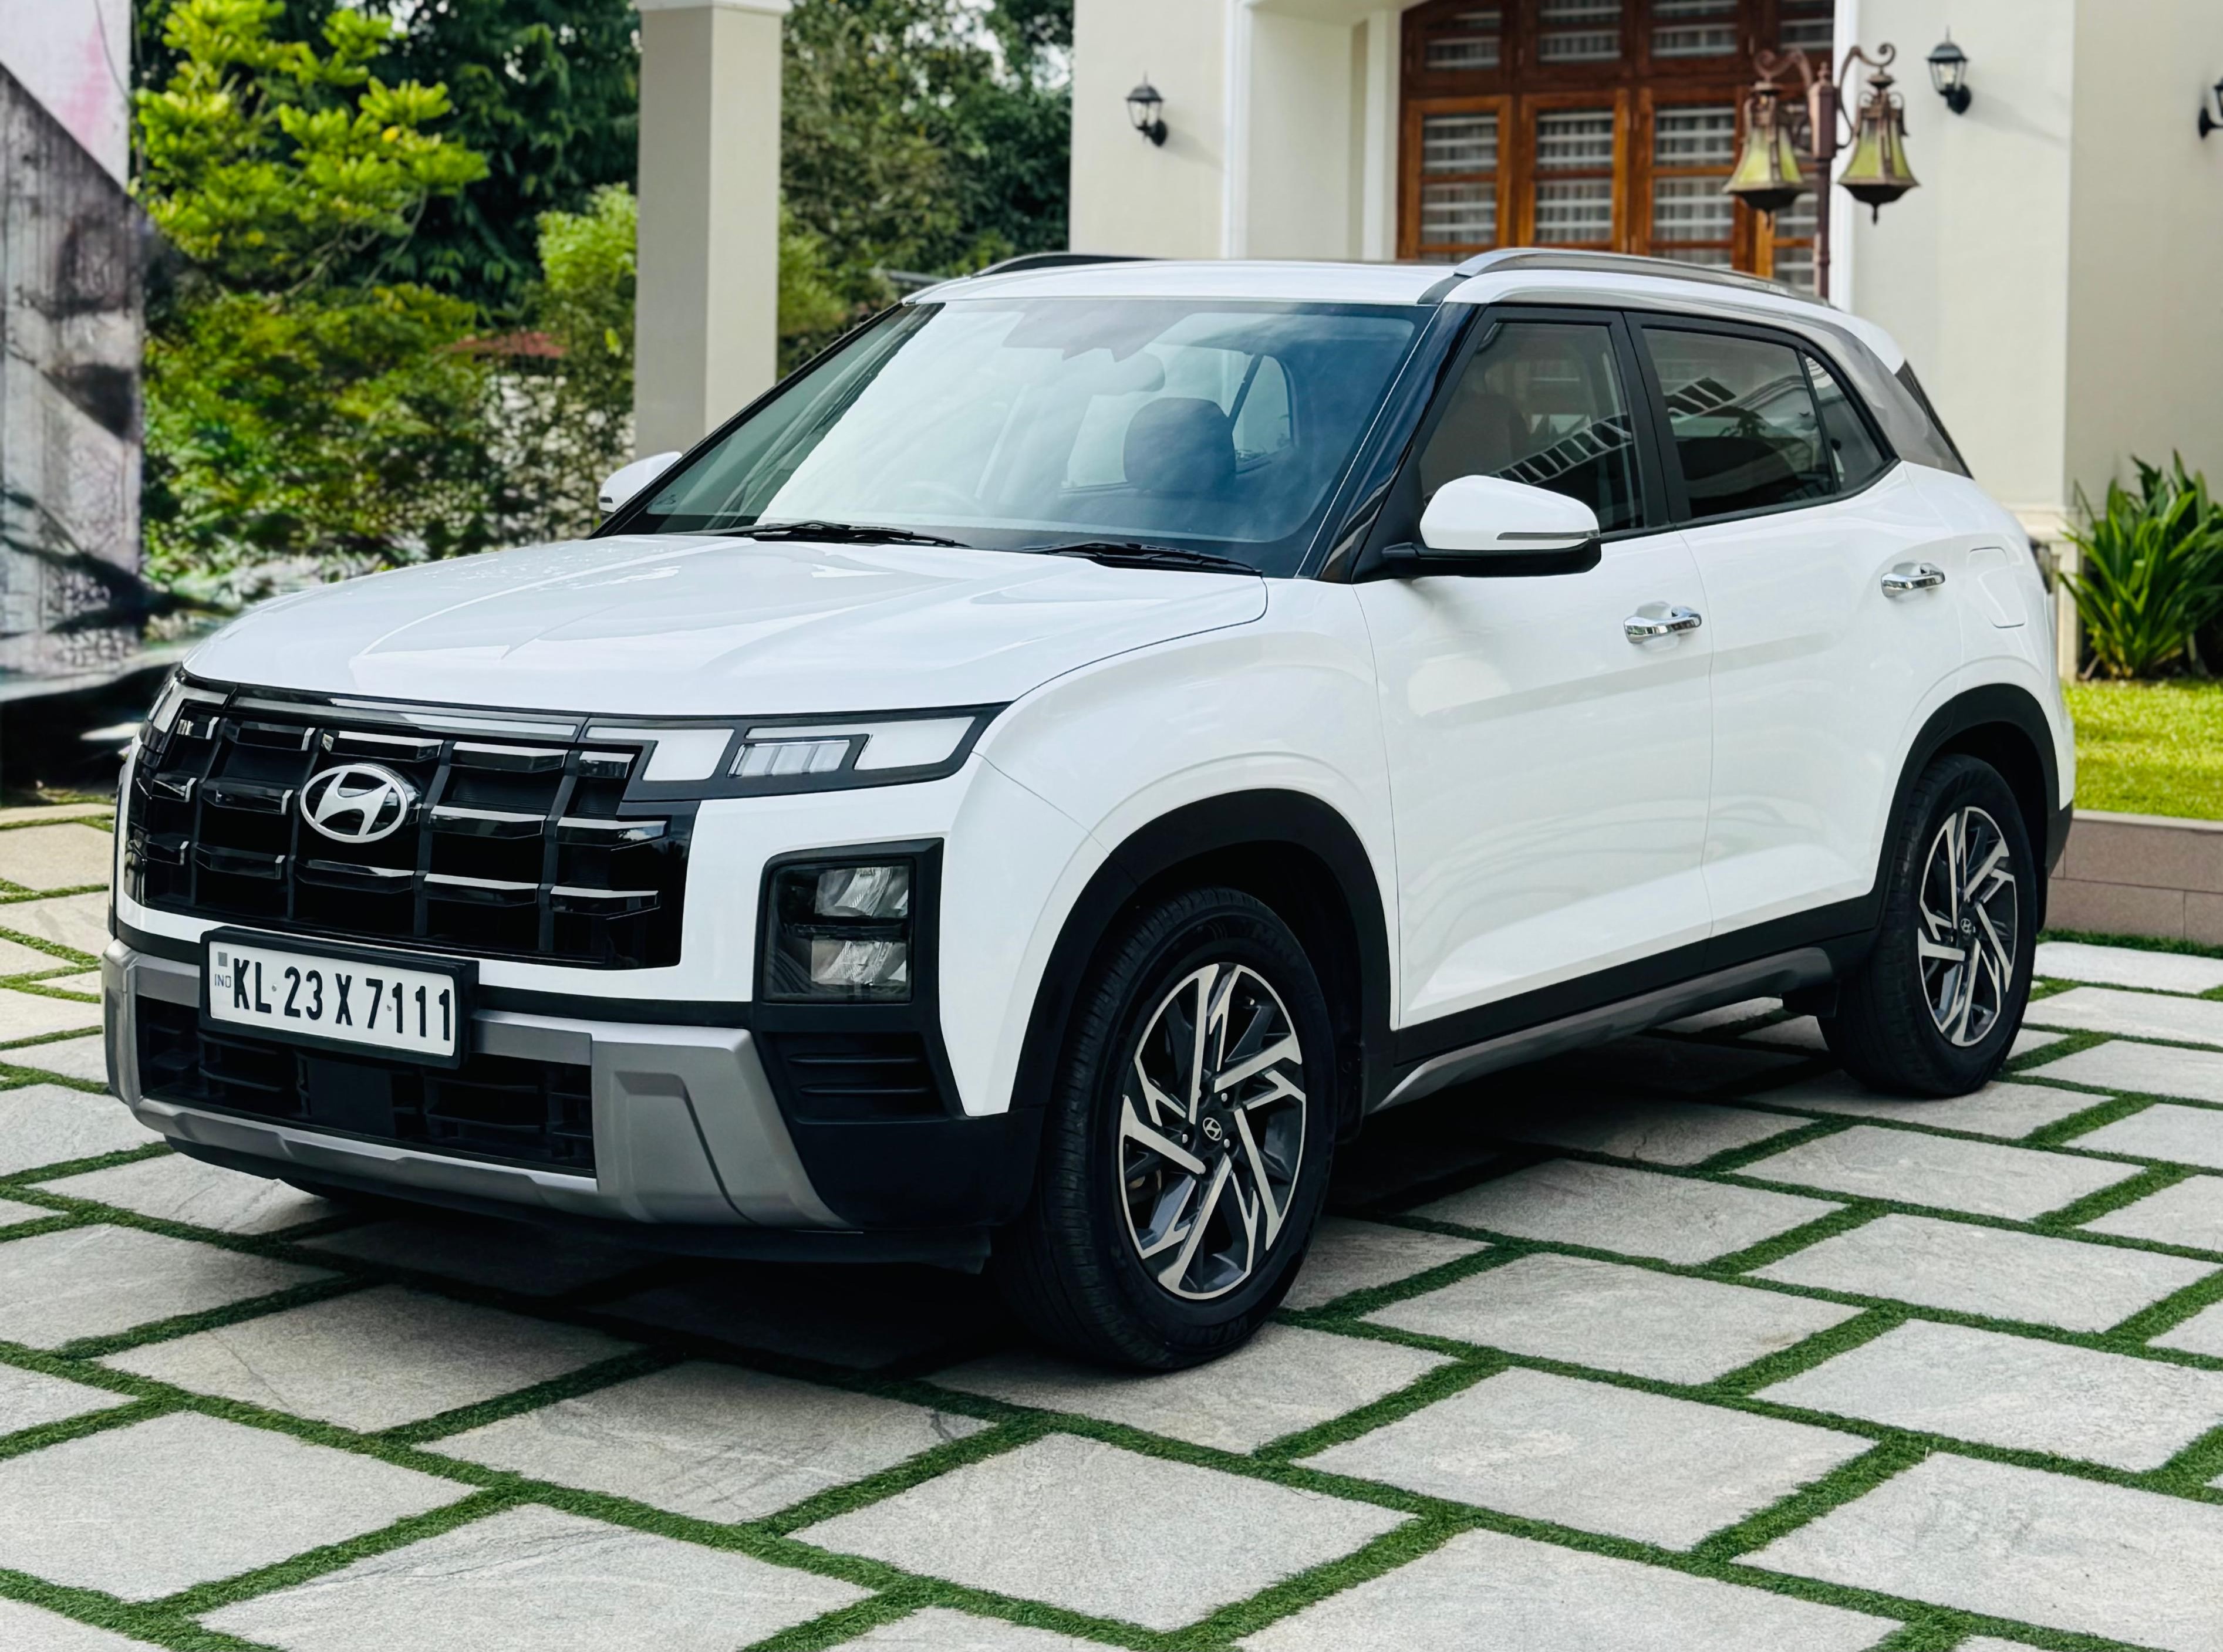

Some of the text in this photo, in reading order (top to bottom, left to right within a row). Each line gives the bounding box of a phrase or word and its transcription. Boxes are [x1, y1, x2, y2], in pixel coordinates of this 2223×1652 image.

[214, 974, 231, 988] IND
[234, 958, 450, 1041] KL 23 X 7111
